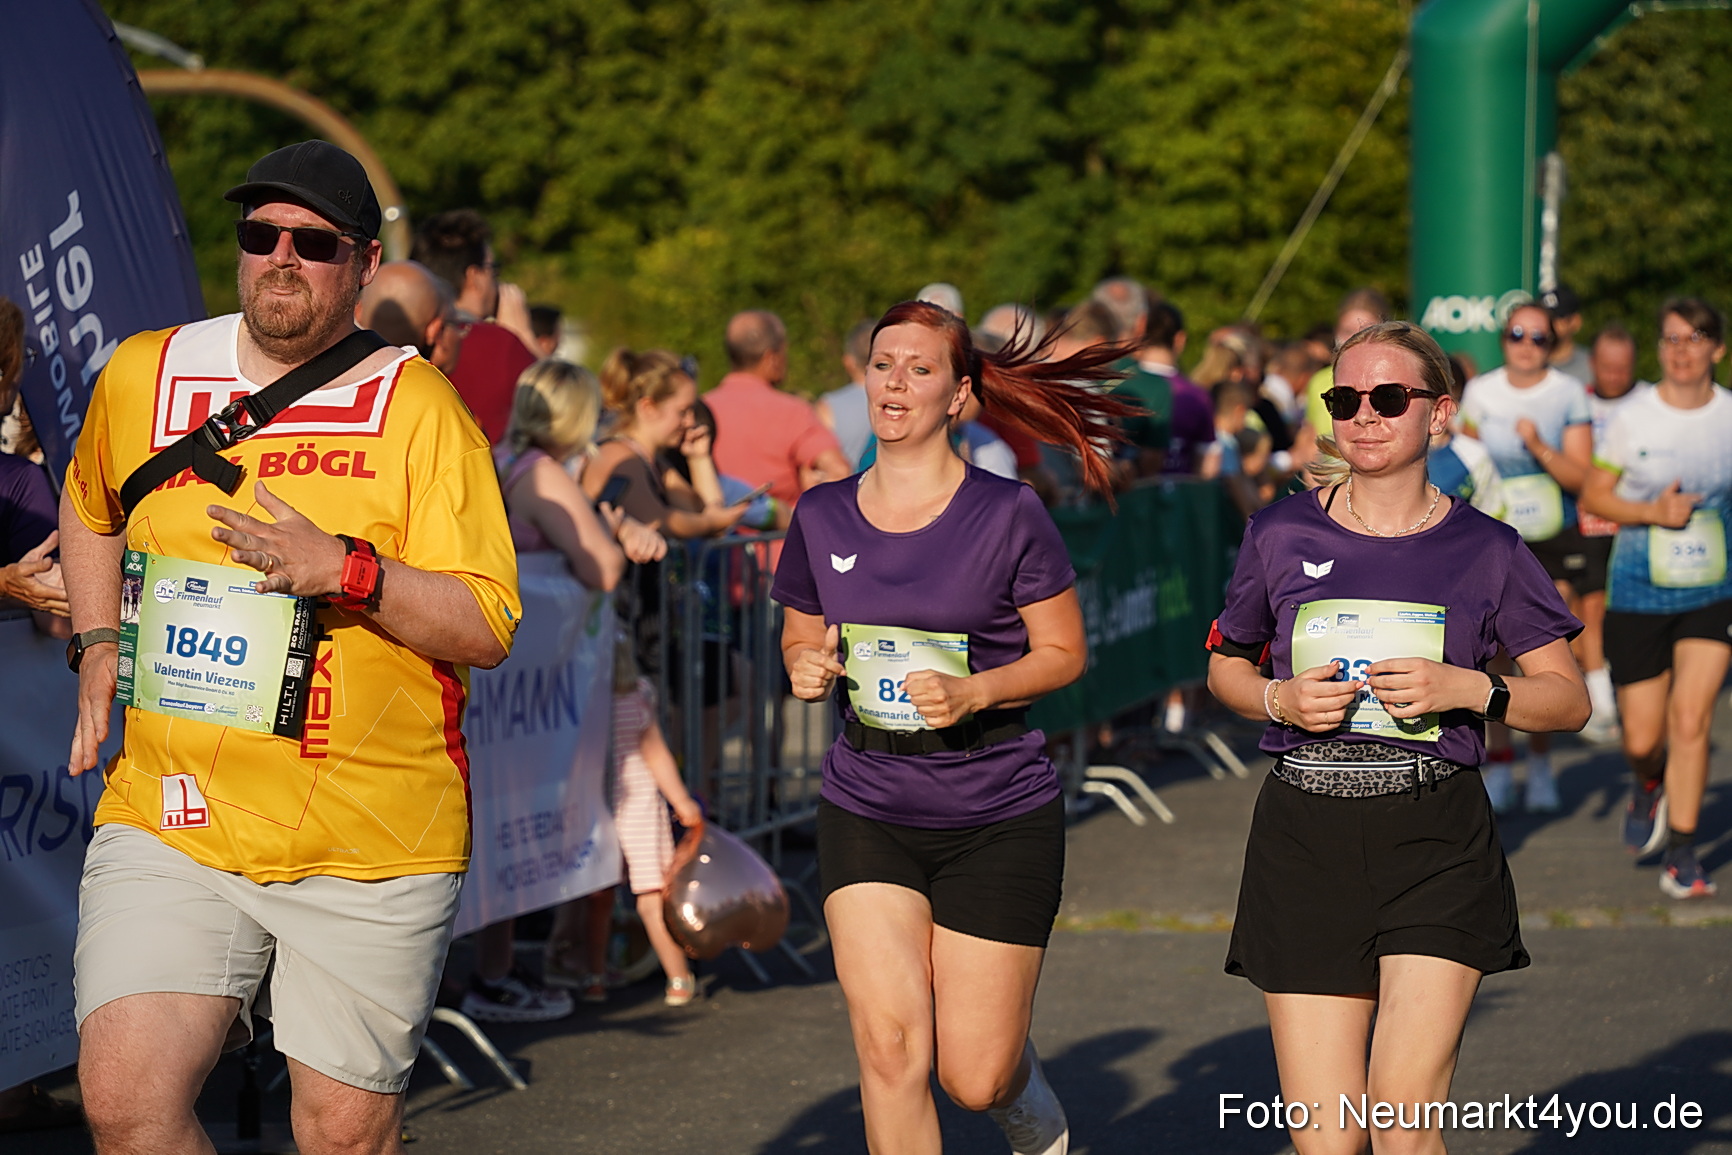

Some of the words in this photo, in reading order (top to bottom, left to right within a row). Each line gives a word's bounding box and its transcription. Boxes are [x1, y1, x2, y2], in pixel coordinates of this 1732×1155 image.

[1420, 295, 1497, 334] AOK
[258, 442, 377, 480] BÖGL
[126, 562, 143, 572] AOK
[176, 592, 224, 605] Firmenlauf
[165, 624, 248, 666] 1849
[290, 635, 298, 648] 20
[297, 618, 306, 649] FACTORY
[1331, 626, 1374, 635] Firmenlauf
[154, 661, 202, 682] Valentin
[205, 671, 256, 691] Viezens
[279, 681, 295, 726] HILTL
